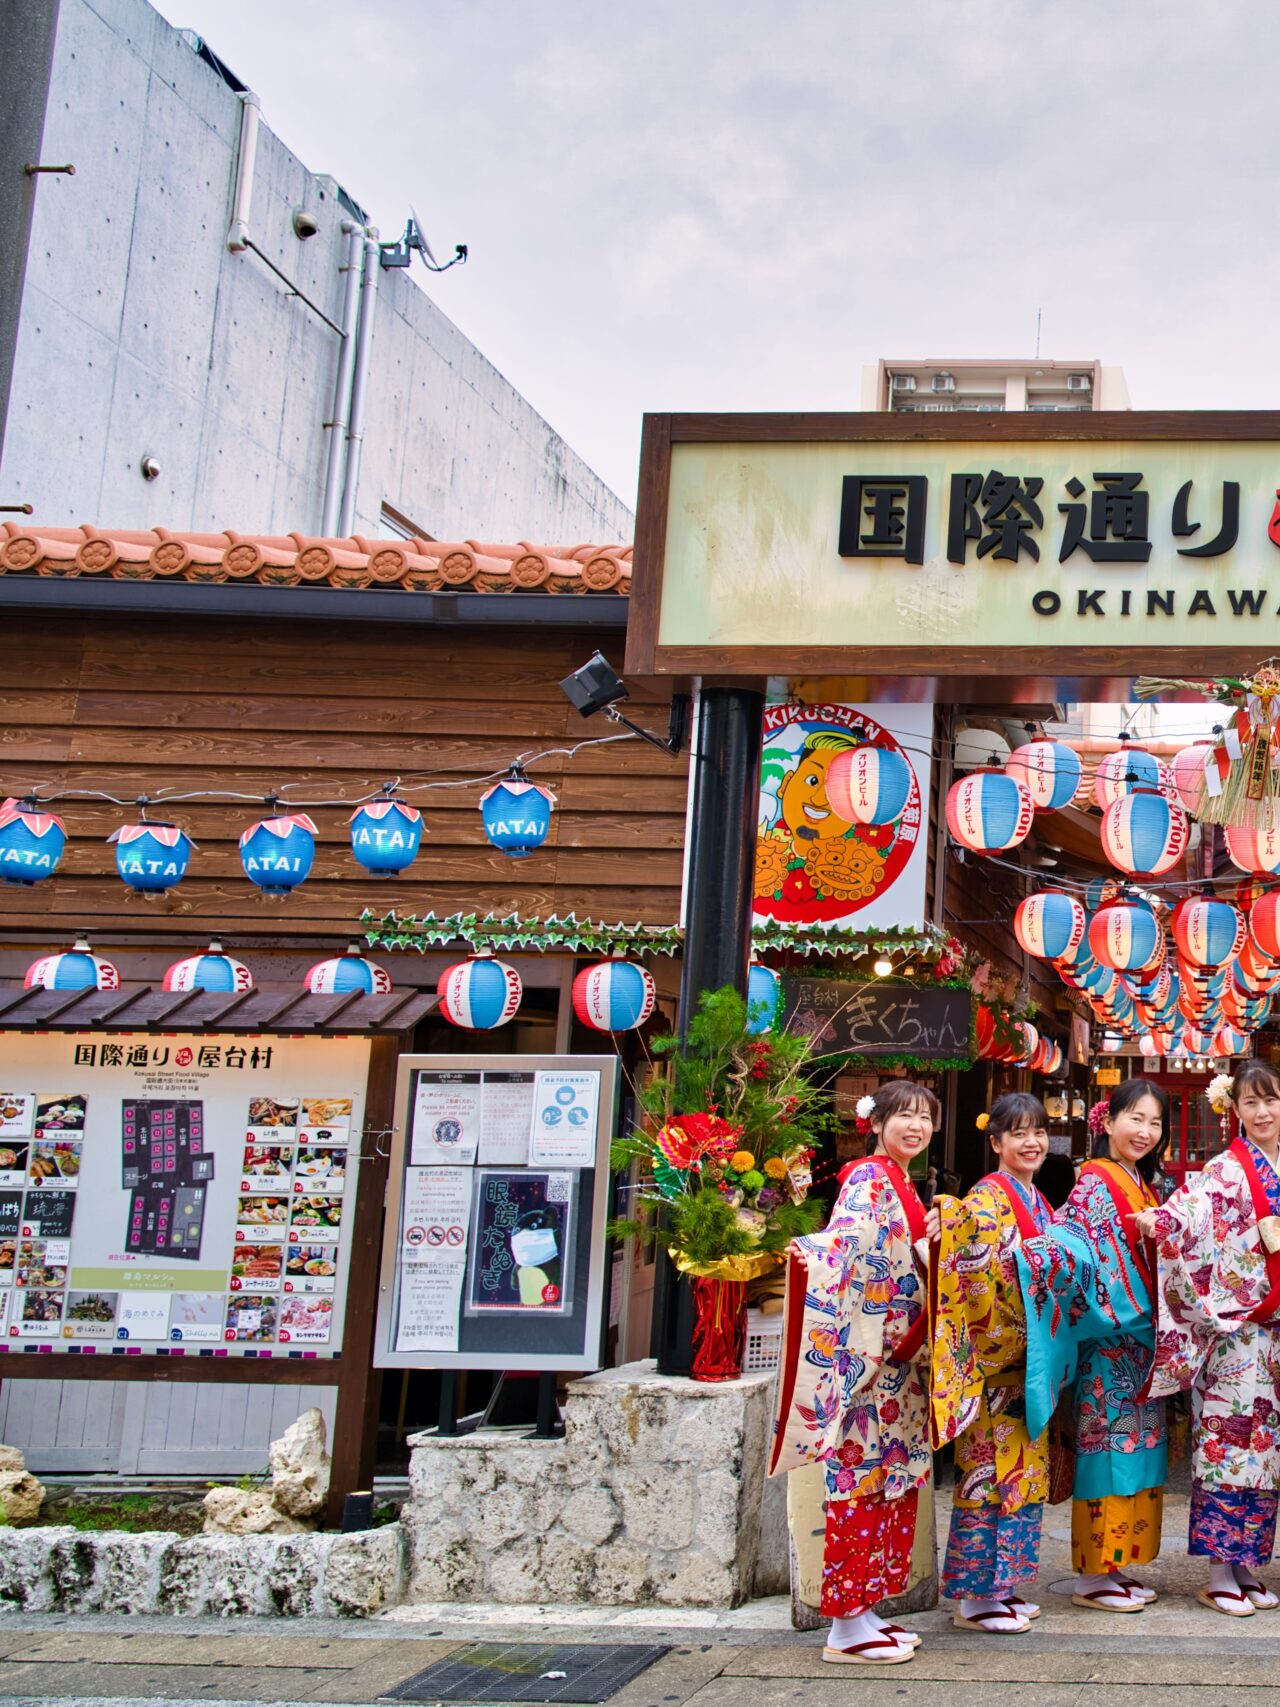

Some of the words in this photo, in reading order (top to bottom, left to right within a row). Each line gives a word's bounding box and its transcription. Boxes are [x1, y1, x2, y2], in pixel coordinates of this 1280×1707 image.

[838, 470, 1240, 564] 国際通り
[858, 753, 869, 807] オリオンビール
[488, 818, 546, 838] YATAI
[964, 782, 975, 835] オリオンビール
[1112, 800, 1124, 850] オリオンビール
[352, 828, 416, 849] YATAI
[119, 859, 188, 876] YATAI
[1115, 913, 1124, 957] オリオンビール
[453, 970, 464, 1018] オリオンビール
[592, 971, 604, 1021] オリオンビール
[846, 994, 969, 1048] きくちゃん
[74, 1044, 170, 1067] 国際通り
[198, 1045, 274, 1069] 屋台村
[481, 1180, 519, 1290] 眼鏡たぬき
